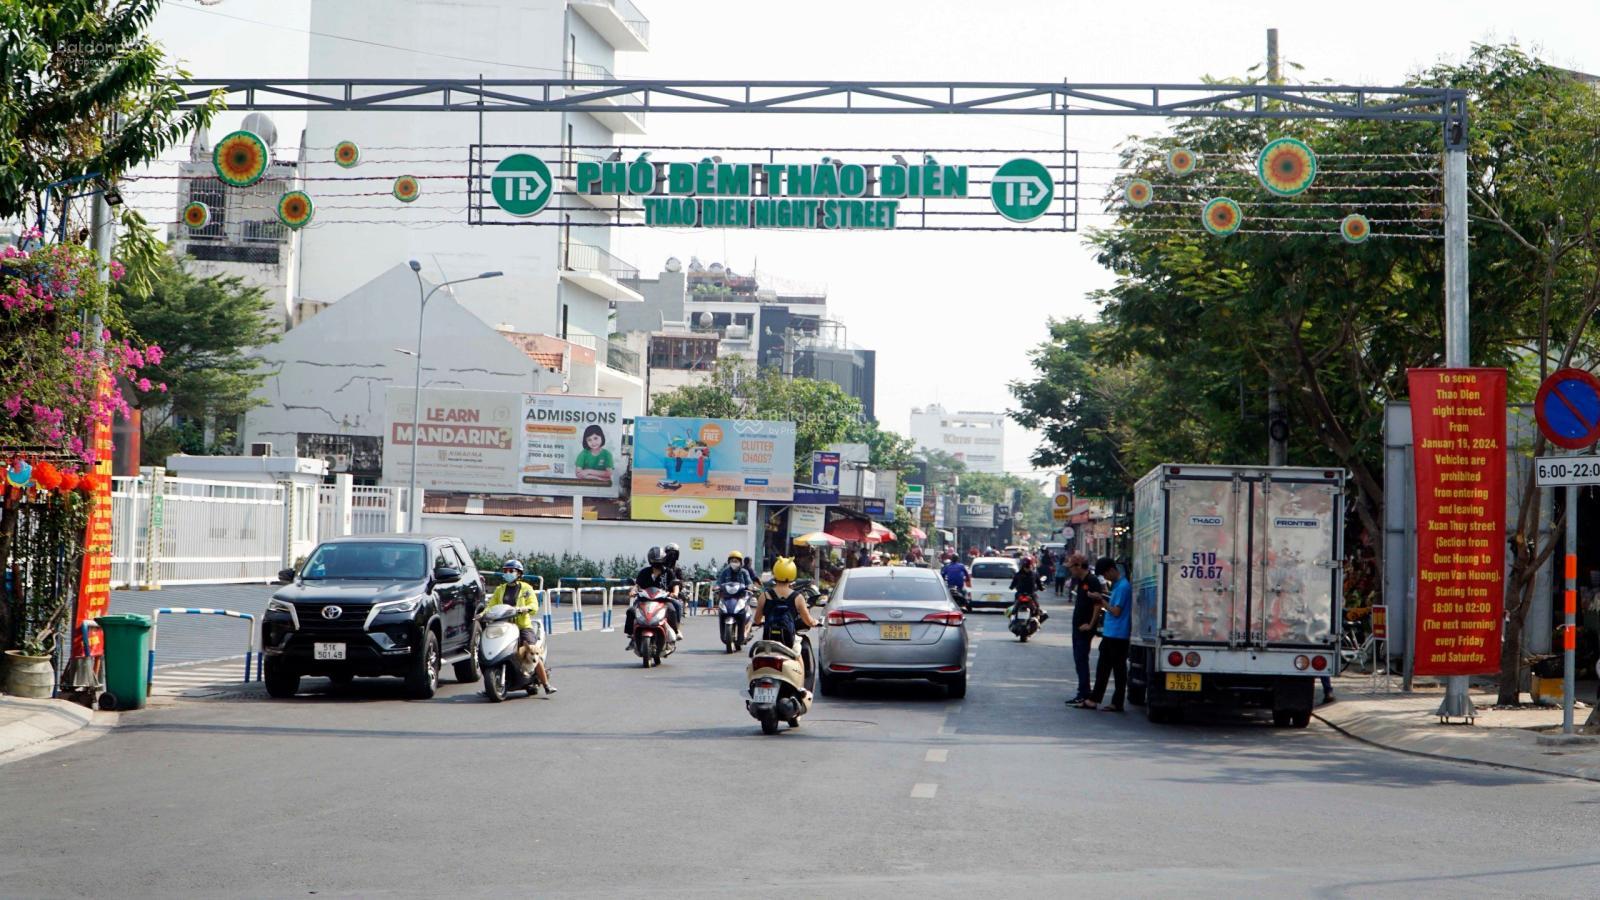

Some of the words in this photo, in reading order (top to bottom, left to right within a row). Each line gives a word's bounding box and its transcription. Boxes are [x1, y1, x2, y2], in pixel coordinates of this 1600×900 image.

[667, 156, 751, 196] ĐÊM
[763, 156, 866, 197] THẢO
[880, 155, 968, 198] ĐIỀN
[643, 198, 697, 227] THAO
[702, 198, 751, 228] DIEN
[754, 199, 818, 229] NIGHT
[823, 200, 899, 229] STREET
[1439, 373, 1450, 383] To
[1452, 375, 1477, 383] serve
[1436, 389, 1458, 399] Thao
[1460, 389, 1480, 400] Dien
[427, 407, 480, 423] LEARN
[526, 408, 616, 424] ADMISSIONS
[1433, 405, 1455, 417] night
[1456, 406, 1485, 416] street.
[1449, 422, 1469, 432] From
[396, 426, 512, 448] MANDARIN?
[703, 432, 720, 441] FREE
[741, 440, 774, 452] CLUTTER
[1422, 438, 1454, 449] January
[1473, 439, 1498, 449] 2024.
[742, 453, 772, 464] CHAOS?
[1435, 454, 1469, 465] Vehicles
[1471, 457, 1486, 465] are
[1440, 471, 1481, 483] prohibited
[1435, 488, 1452, 497] from
[1453, 488, 1488, 500] entering
[966, 504, 983, 514] H2M
[1439, 504, 1453, 514] and
[1453, 504, 1484, 516] leaving
[1428, 520, 1448, 530] Xuan
[1450, 520, 1468, 532] Thuy
[1470, 521, 1496, 531] street
[1436, 537, 1467, 548] (Section
[1468, 537, 1488, 547] from
[1192, 552, 1216, 565] 51D
[1434, 553, 1451, 564] Quoc
[1453, 554, 1479, 566] Huong
[1482, 554, 1491, 563] to
[1180, 566, 1223, 579] 376.67
[1421, 570, 1450, 582] Nguyen
[1451, 570, 1466, 579] Van
[1435, 587, 1465, 598] Starting
[1467, 587, 1488, 596] from
[1432, 603, 1453, 613] 18:00
[1455, 604, 1464, 613] to
[1465, 603, 1491, 613] 02:00
[1423, 619, 1440, 631] (The
[1443, 620, 1459, 629] next
[1461, 620, 1497, 631] morning)
[1435, 638, 1456, 647] every
[1458, 635, 1485, 647] Friday
[1431, 652, 1446, 662] and
[1448, 652, 1486, 663] Saturday.
[1176, 673, 1192, 682] 51D
[1170, 681, 1197, 689] 376.67
